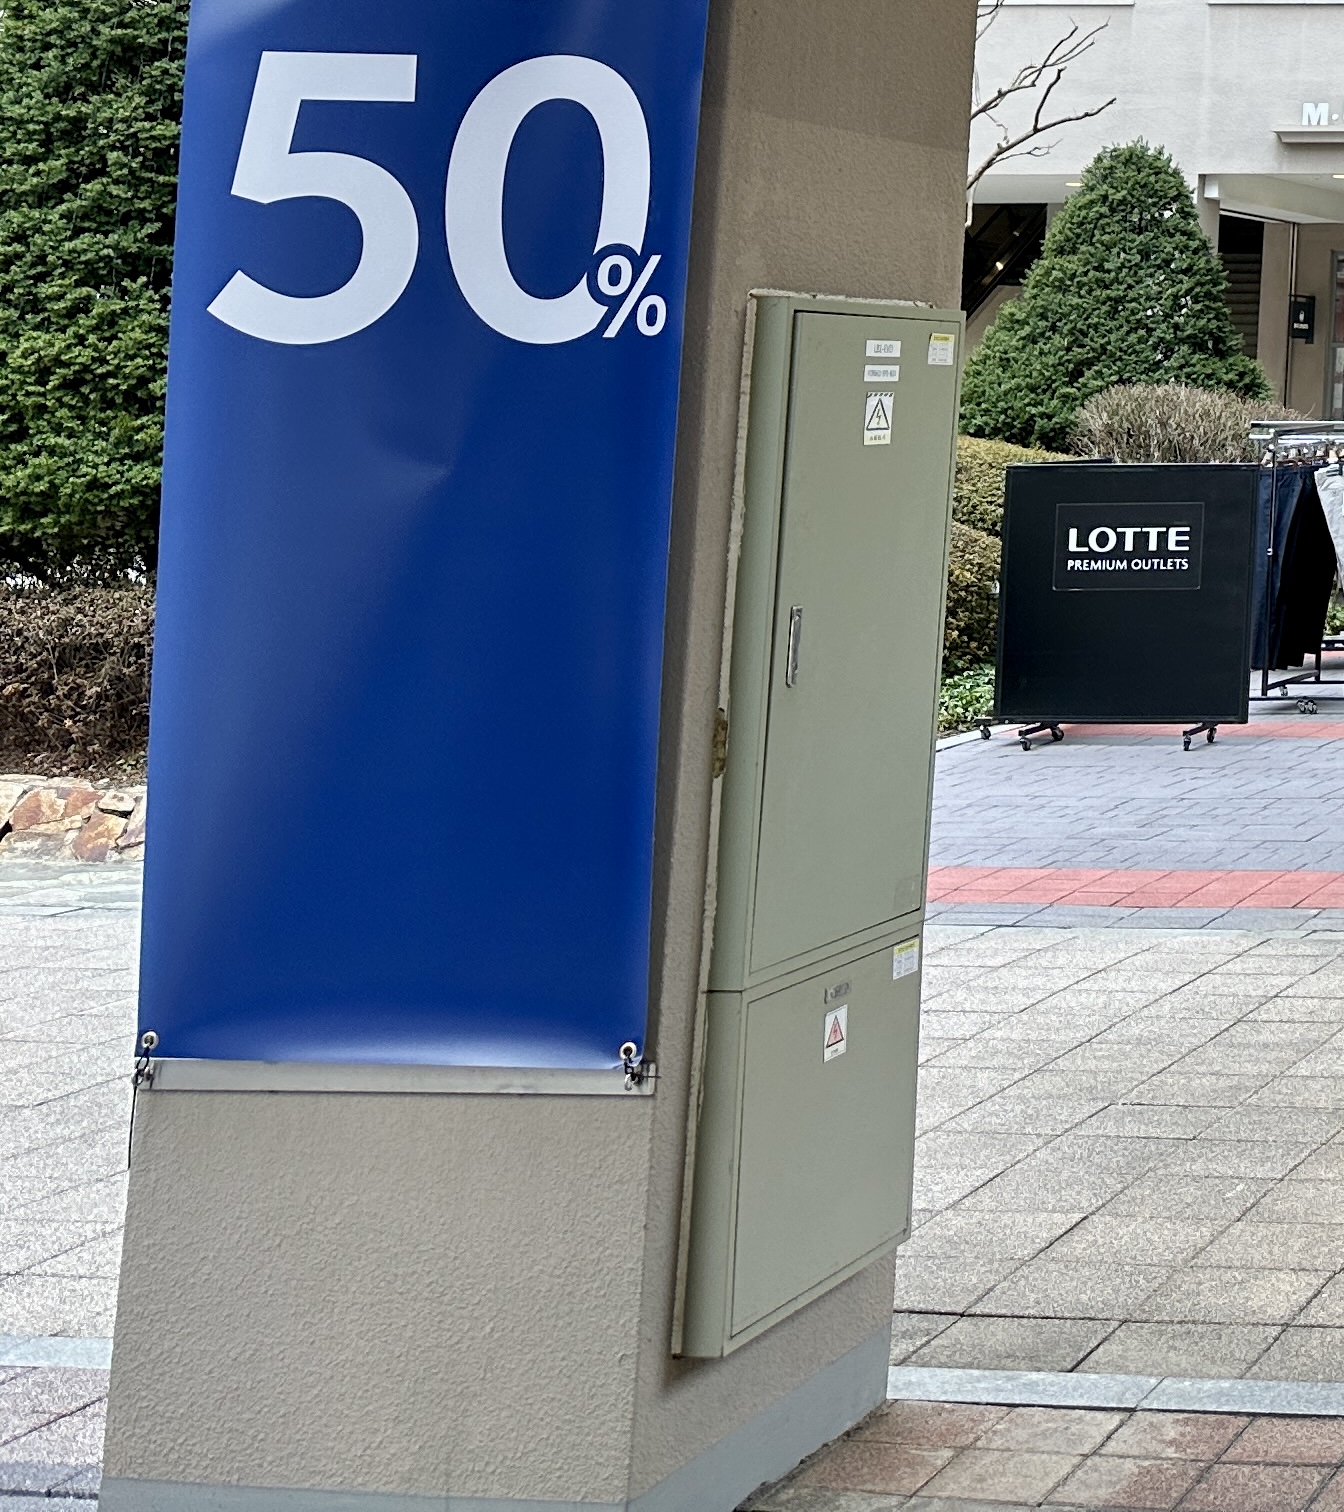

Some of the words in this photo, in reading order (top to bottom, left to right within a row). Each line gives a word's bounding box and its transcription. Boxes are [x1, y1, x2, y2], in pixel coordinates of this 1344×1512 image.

[206, 50, 667, 345] 50%
[1068, 527, 1190, 552] LOTTE
[1067, 559, 1127, 570] PREMIUM
[1131, 558, 1189, 570] OUTLETS
